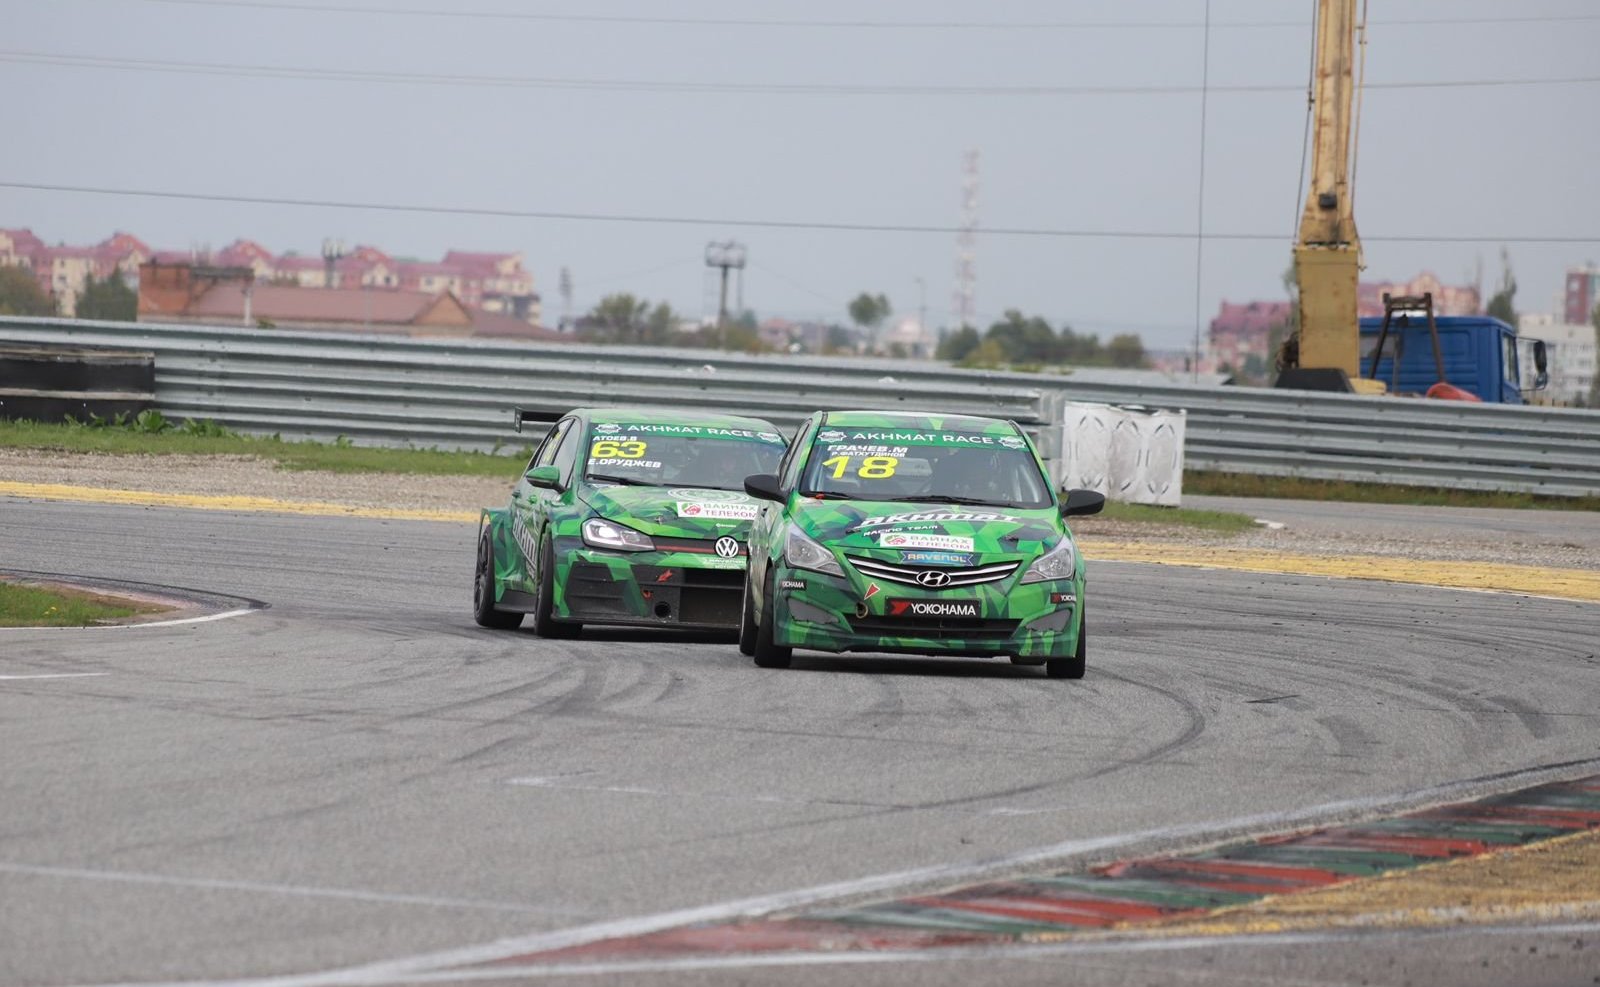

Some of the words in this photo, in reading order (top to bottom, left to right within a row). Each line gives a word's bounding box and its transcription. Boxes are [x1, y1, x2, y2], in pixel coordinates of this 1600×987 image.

[627, 424, 703, 435] AKHMAT
[707, 427, 755, 438] RACE
[853, 432, 937, 442] AKHMAT
[943, 434, 994, 445] RACE
[591, 441, 648, 459] 63
[827, 444, 909, 454] ГРАЧЕВ.М
[822, 456, 899, 479] 18
[909, 541, 972, 551] ТЕЛЕКОМ
[907, 553, 967, 563] RAVENOL
[910, 602, 977, 616] YOKOHAMA
